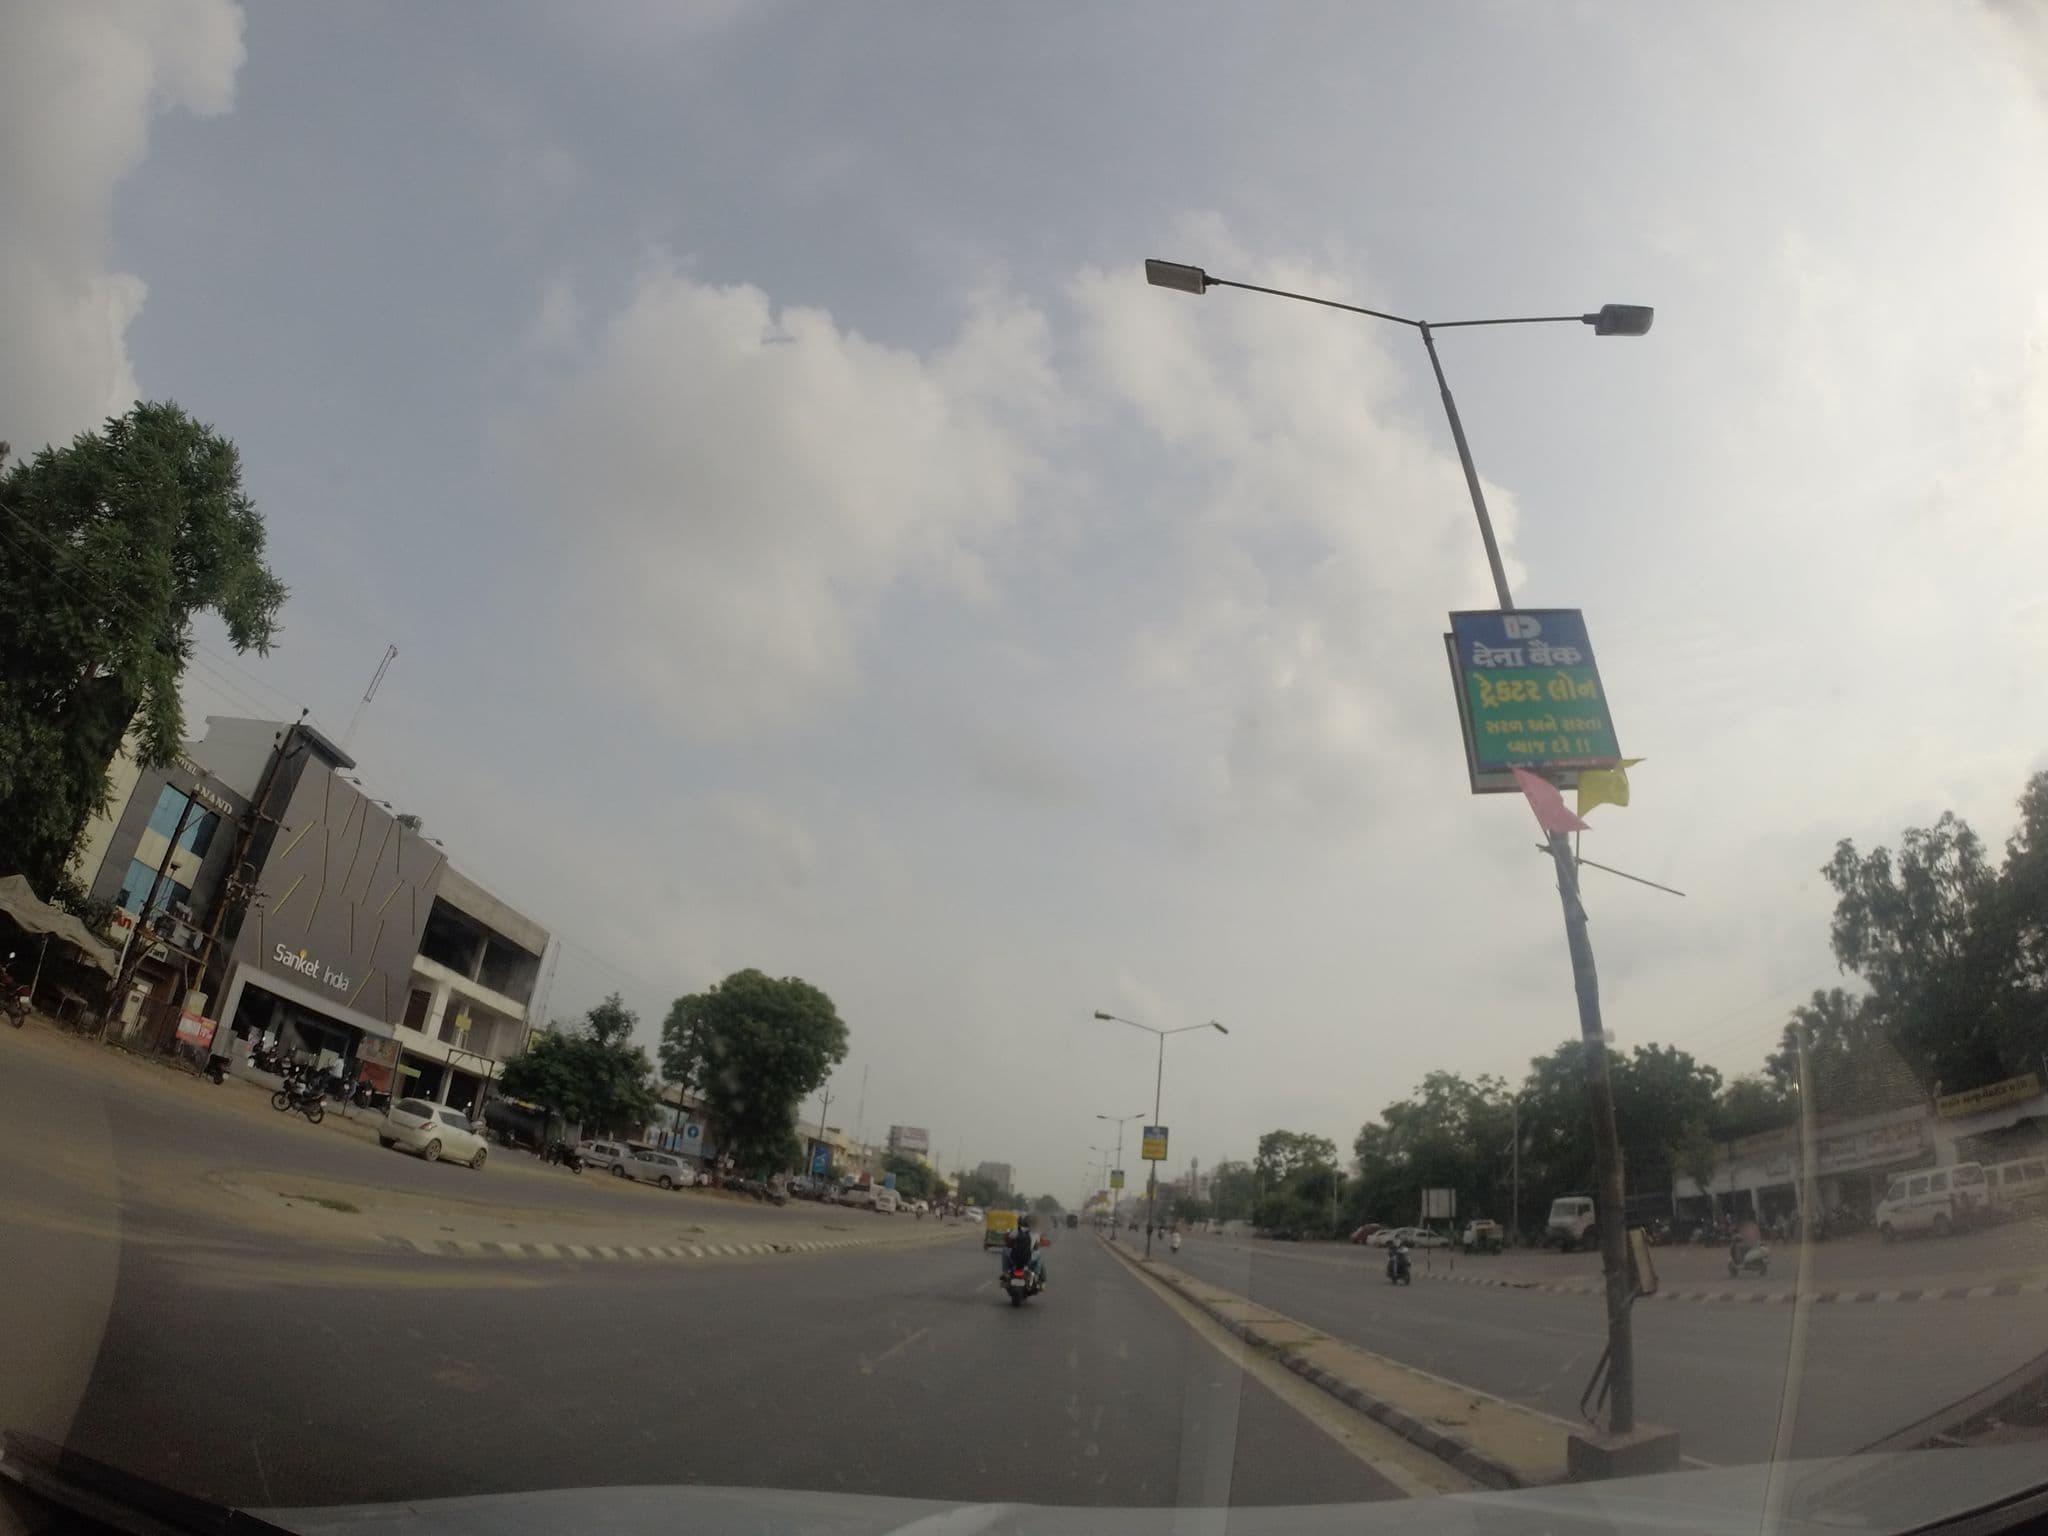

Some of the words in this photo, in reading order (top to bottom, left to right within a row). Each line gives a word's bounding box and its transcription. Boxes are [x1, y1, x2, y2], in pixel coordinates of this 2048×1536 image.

[1471, 639, 1527, 668] देना
[193, 782, 233, 815] ANAND
[273, 943, 321, 979] Sanket
[323, 966, 351, 992] India
